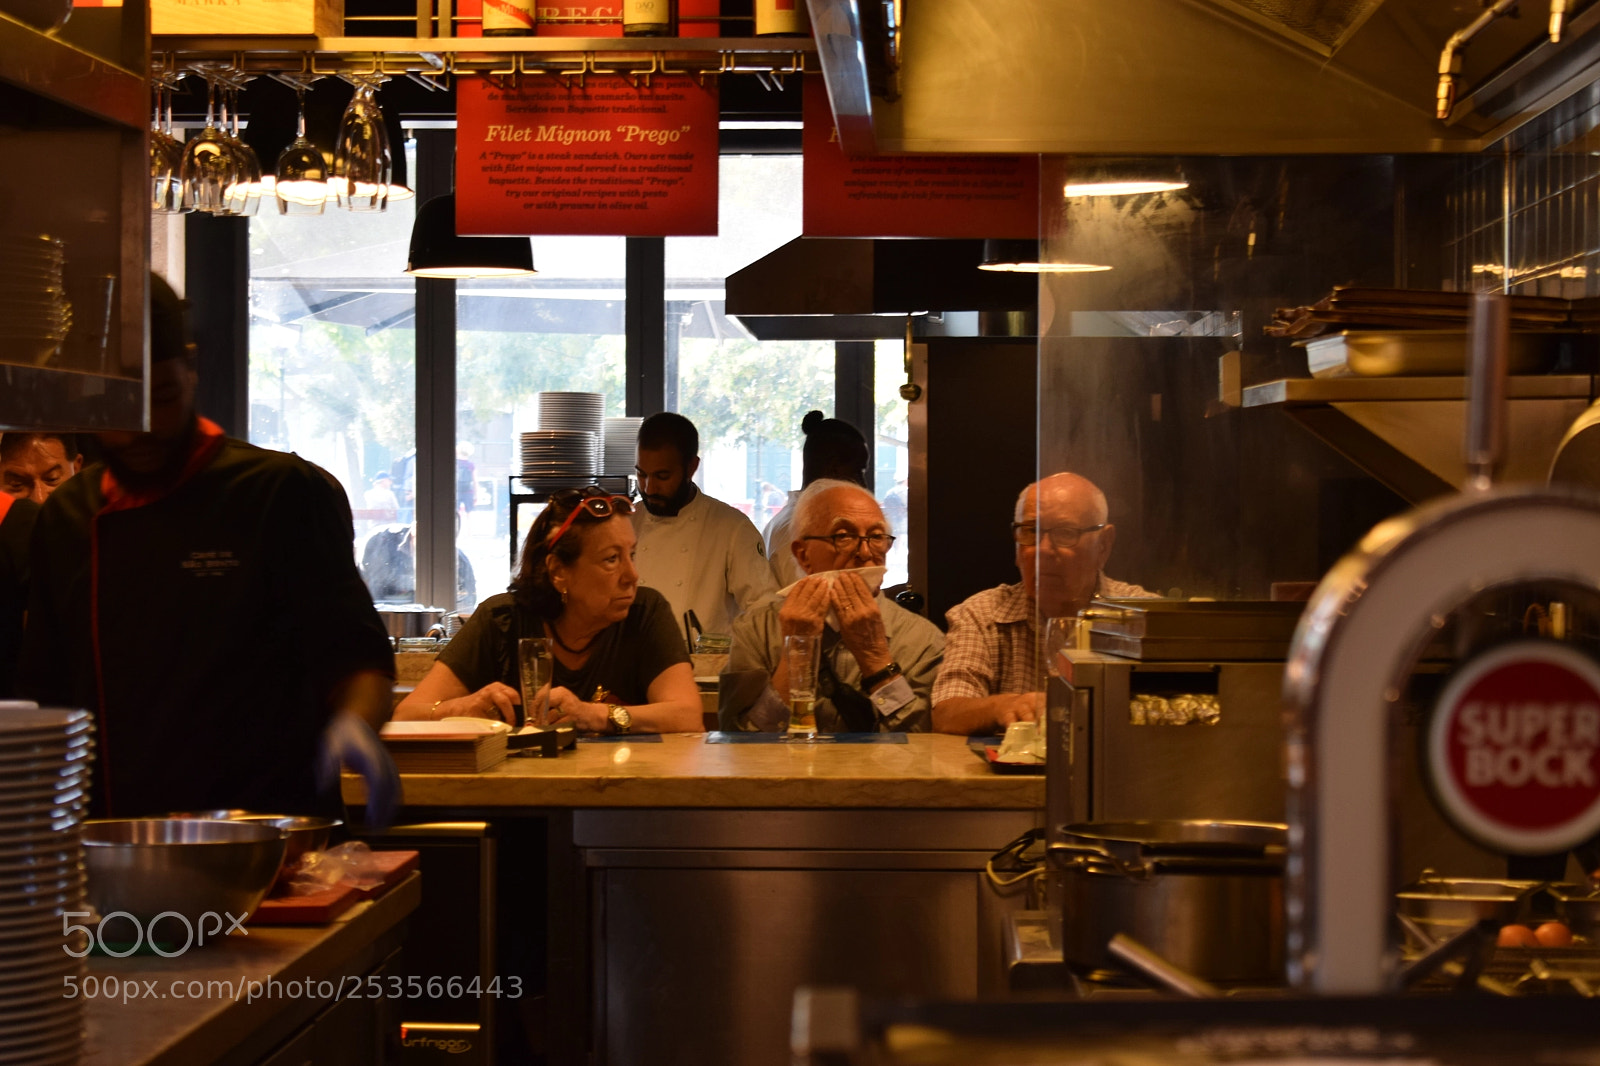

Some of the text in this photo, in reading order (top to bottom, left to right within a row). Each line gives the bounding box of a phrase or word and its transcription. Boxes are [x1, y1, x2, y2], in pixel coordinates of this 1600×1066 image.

[484, 125, 532, 142] Filet
[534, 125, 611, 145] Mignon
[565, 165, 582, 175] and
[575, 176, 588, 187] the
[1457, 701, 1600, 747] SUPER
[1466, 748, 1595, 788] BOCK
